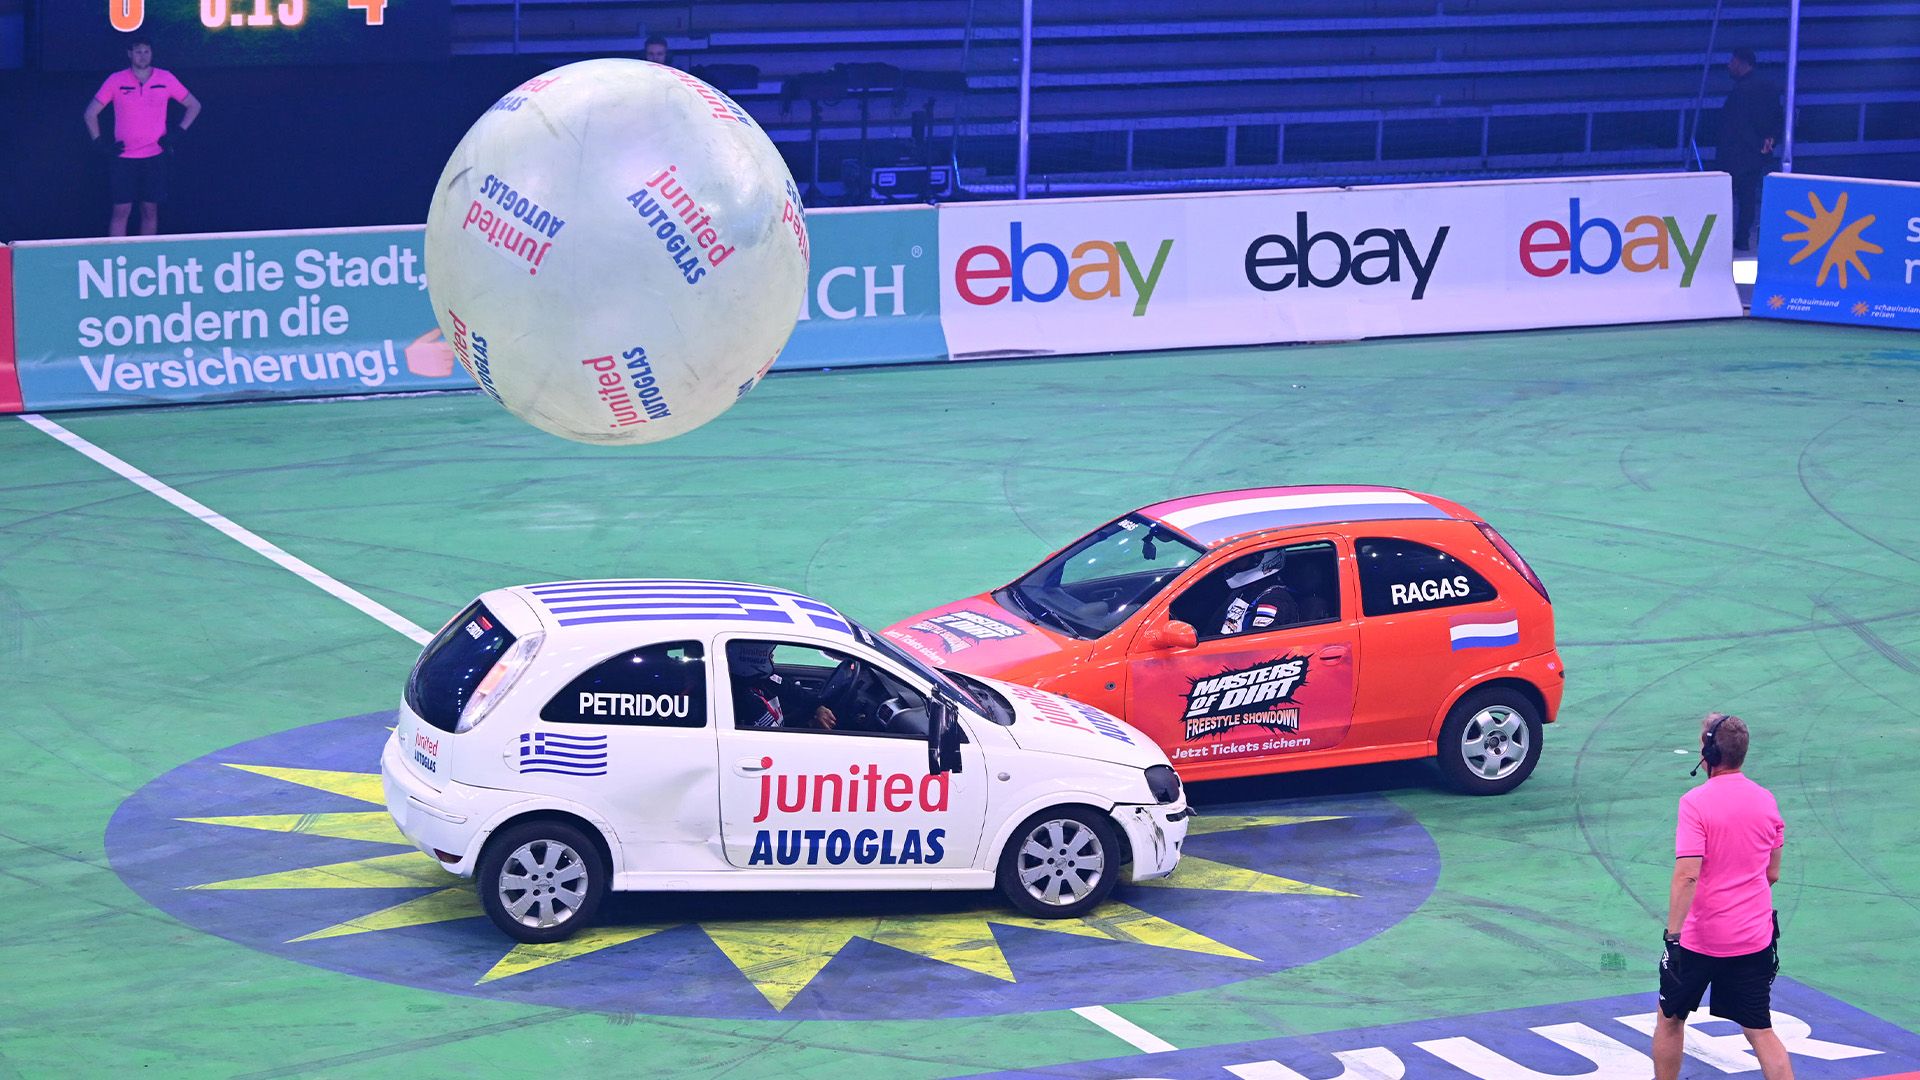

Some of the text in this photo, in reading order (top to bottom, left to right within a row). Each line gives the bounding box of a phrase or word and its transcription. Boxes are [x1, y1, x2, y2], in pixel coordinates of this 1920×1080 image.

[480, 174, 566, 239] AUTOGLAS
[646, 165, 735, 267] junited
[462, 200, 552, 276] junited
[626, 189, 706, 285] AUTOGLAS
[1245, 211, 1451, 300] ebay
[1519, 197, 1718, 288] ebay
[78, 244, 429, 300] Nicht die Stadt,
[954, 221, 1175, 317] ebay
[78, 294, 349, 348] sondern die
[79, 339, 399, 393] Versicherung!
[582, 355, 649, 428] junited
[622, 346, 672, 420] AUTOGLAS
[1391, 575, 1470, 606] RAGAS
[578, 692, 689, 718] PETRIDOU
[1188, 676, 1301, 712] OF DIRT
[1192, 660, 1304, 698] MASTERS
[1171, 737, 1311, 760] Jetzt Tickets sichern
[1185, 708, 1299, 740] FREESTYLE SHOWDOWN
[748, 828, 946, 866] AUTOGLAS
